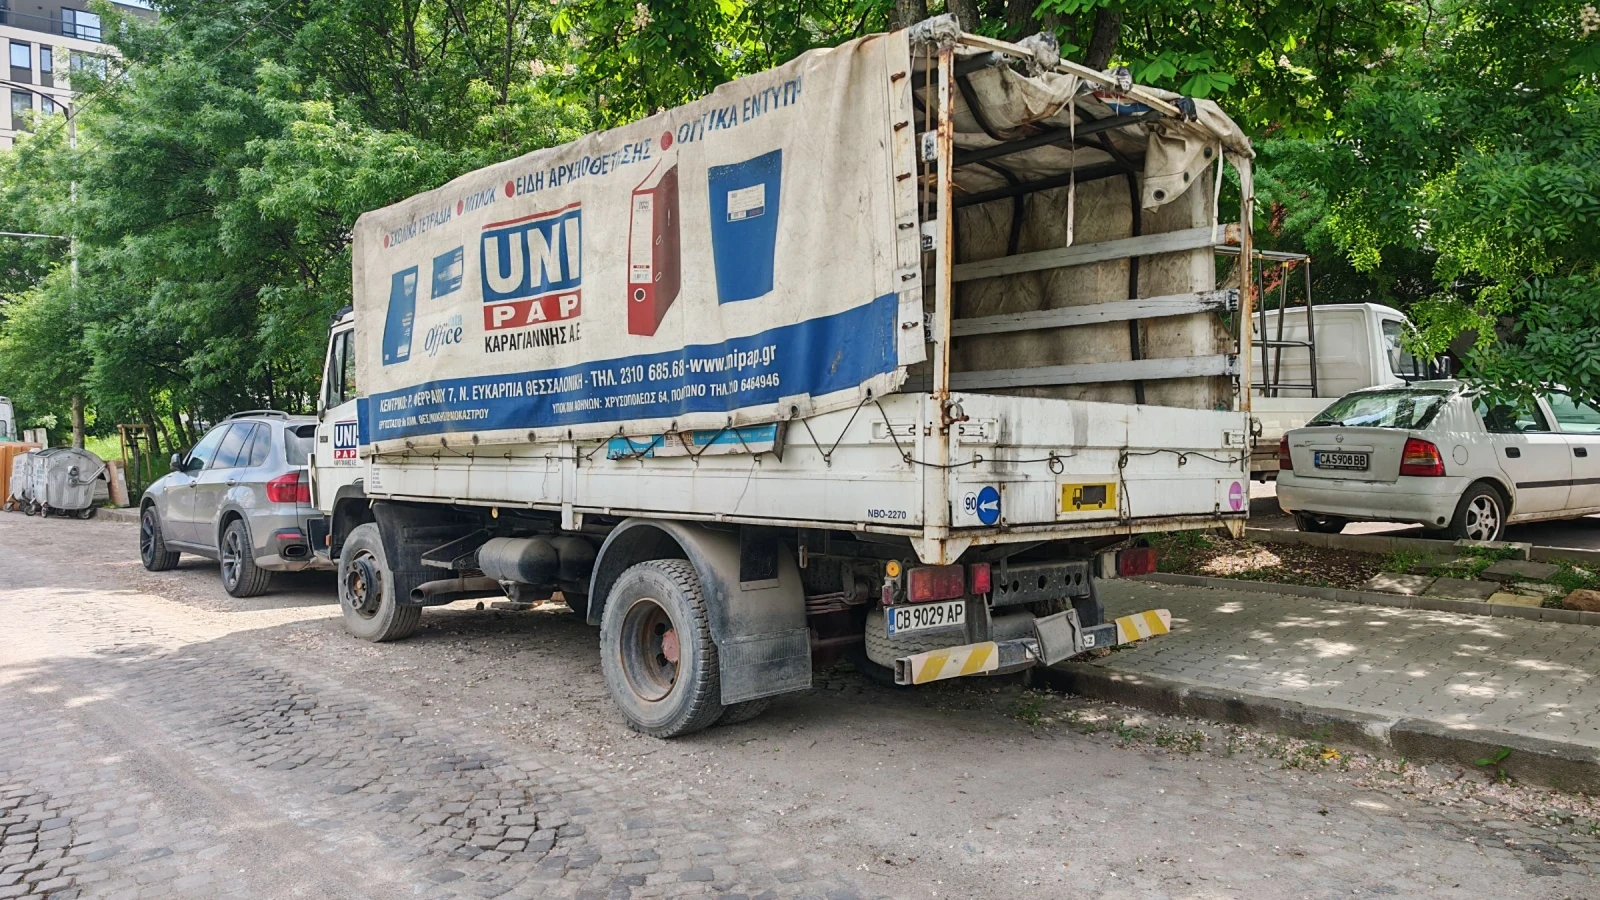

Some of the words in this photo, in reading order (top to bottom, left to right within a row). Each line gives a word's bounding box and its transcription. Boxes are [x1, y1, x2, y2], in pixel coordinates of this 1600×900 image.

[516, 171, 544, 196] ΕΙΔΗ
[464, 187, 497, 214] ΜΠΛΟΚ
[418, 204, 452, 235] ΤΕΤΡΑΔΙΑ
[483, 216, 580, 294] UNI
[492, 294, 579, 328] PAP
[424, 324, 464, 358] Office
[484, 326, 567, 354] ΚΑΡΑΓΙΑΝΝΗΣ
[448, 387, 457, 404] 7,
[460, 386, 470, 401] Ν.
[473, 381, 523, 401] ΕΥΚΑΡΠΙΑ
[526, 373, 583, 396] ΘΕΣΣΑΛΟΝΙΚΗ
[590, 369, 618, 388] ΤΗΛ.
[620, 364, 644, 385] 2310
[604, 391, 657, 409] ΧΡΥΣΟΠΟΛΕΩΣ
[658, 391, 670, 404] 64,
[740, 373, 780, 392] 6464946
[335, 424, 357, 447] UNI
[335, 450, 356, 459] PAP
[1320, 453, 1331, 464] CA
[1331, 455, 1353, 466] 5908
[1353, 455, 1366, 466] BB
[867, 509, 907, 520] NBO-2270
[965, 497, 977, 511] 90
[896, 609, 911, 630] CB
[913, 604, 944, 628] 9029
[946, 603, 963, 623] AP
